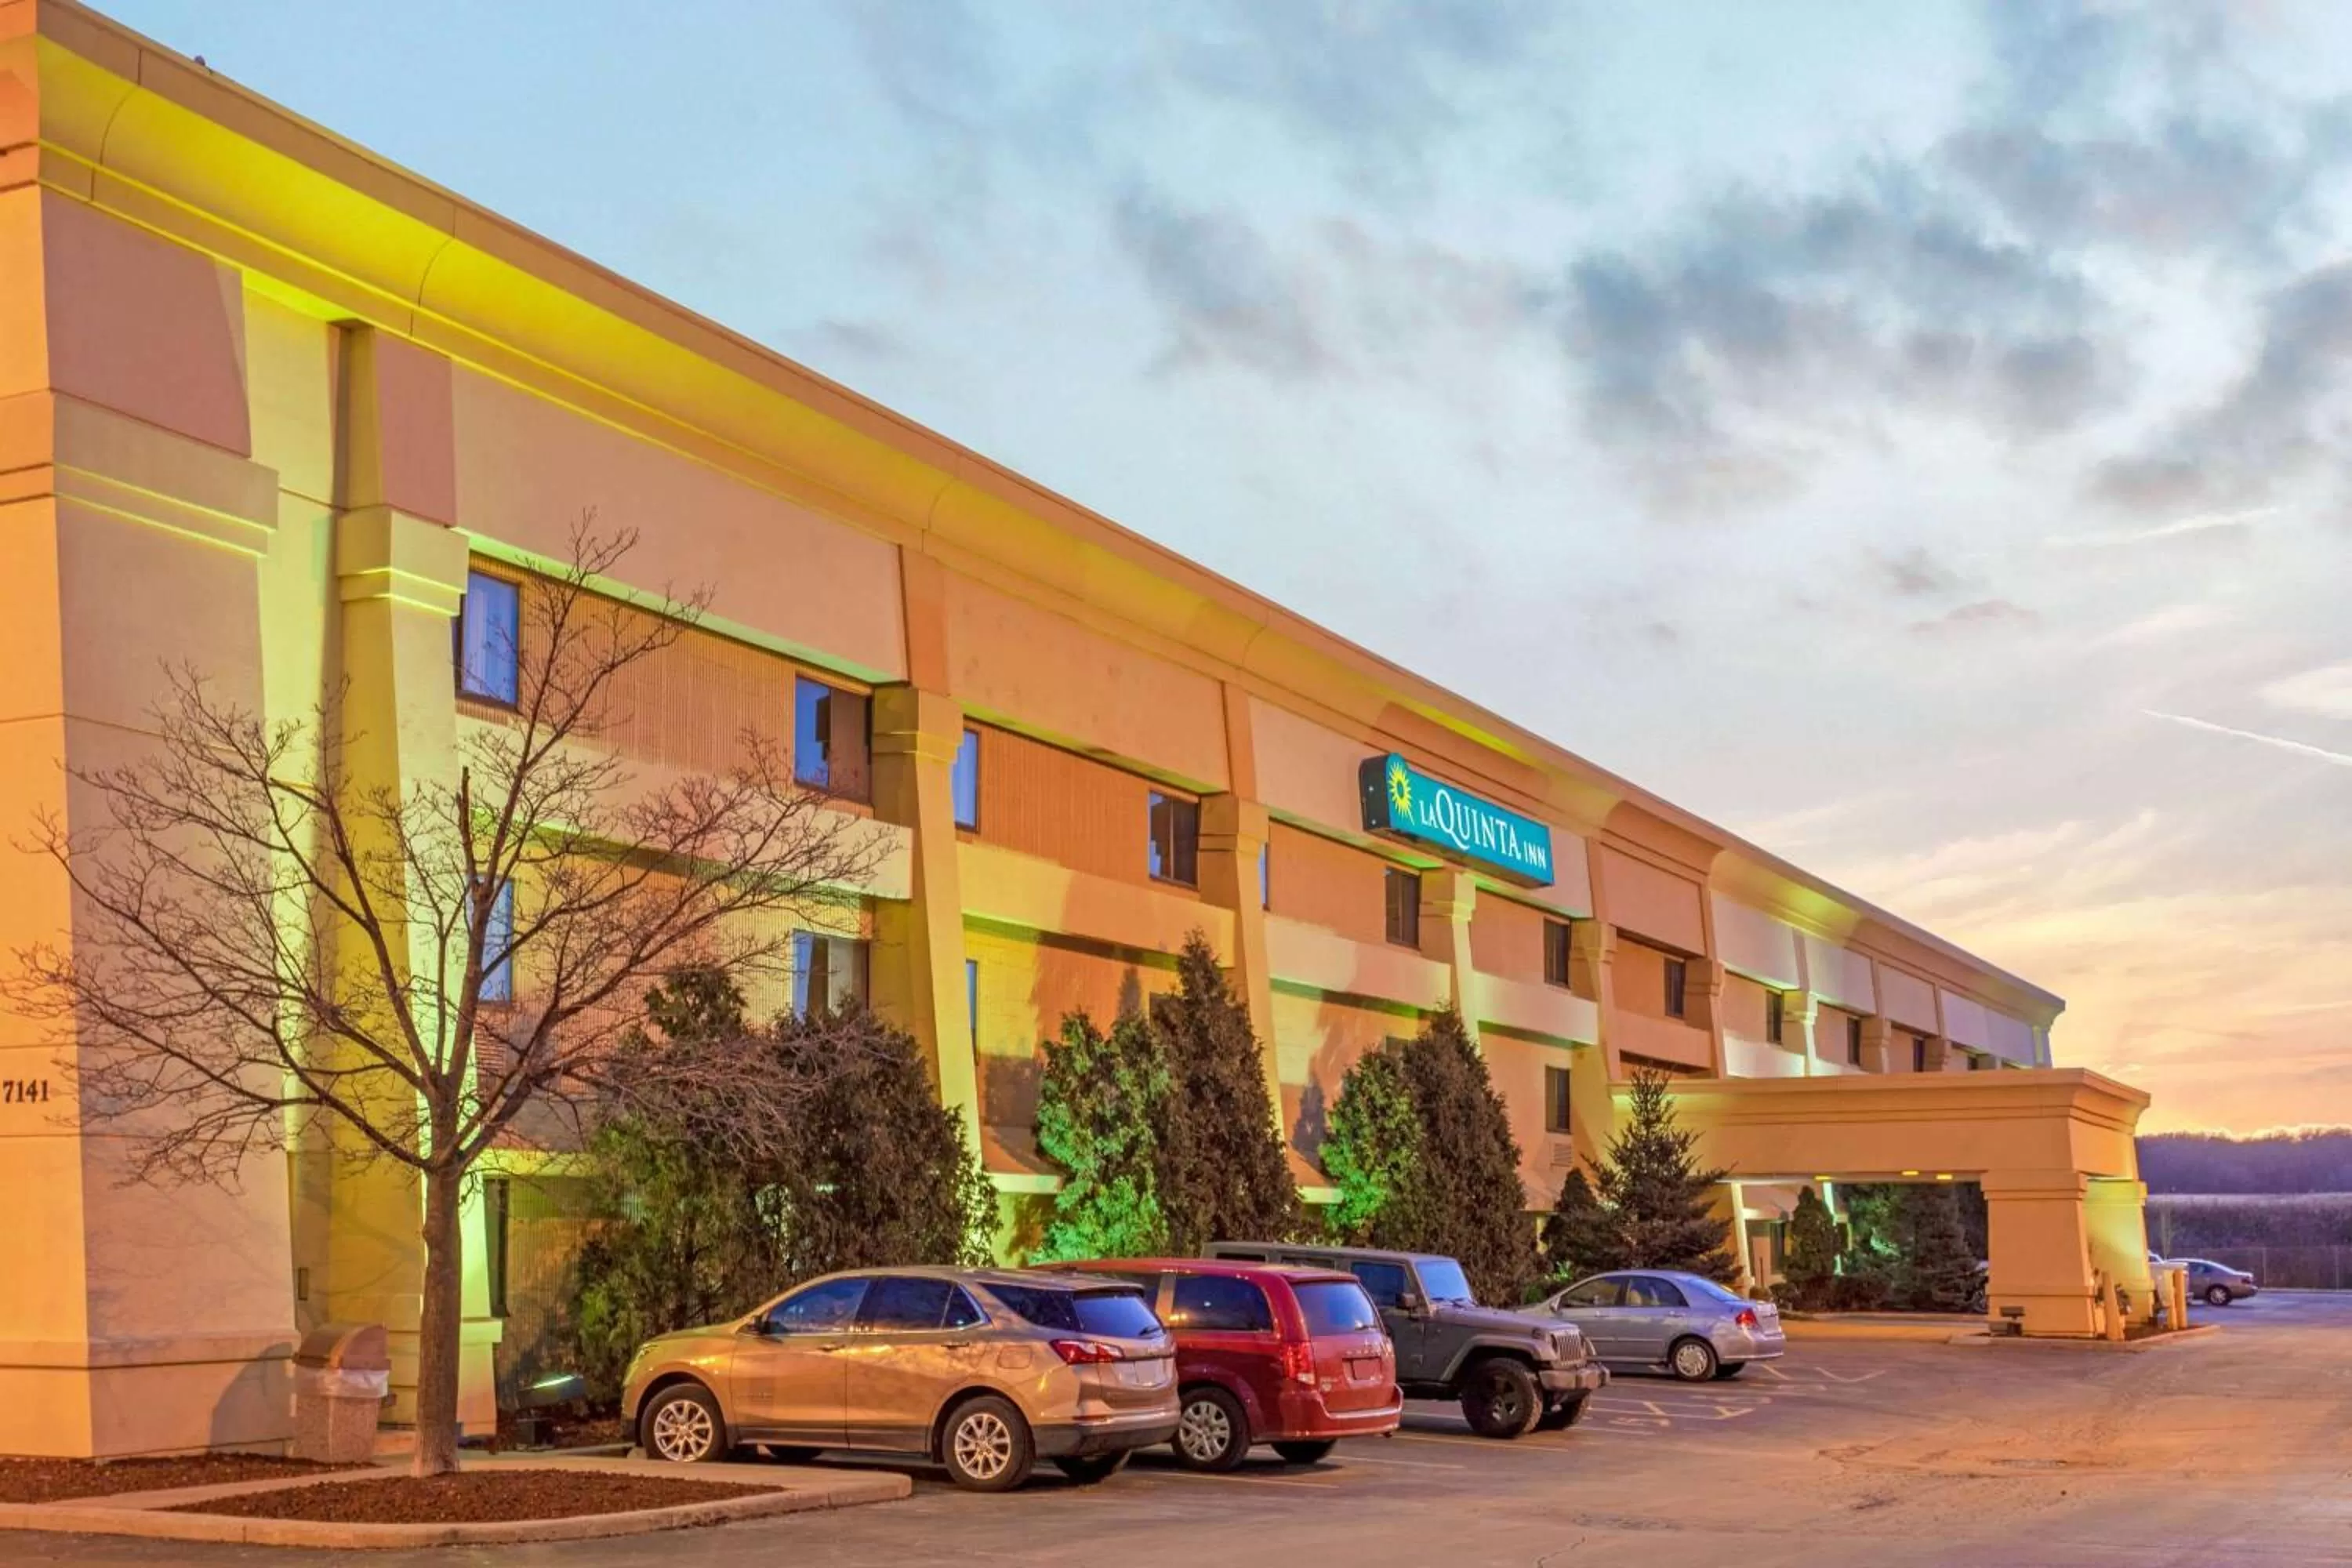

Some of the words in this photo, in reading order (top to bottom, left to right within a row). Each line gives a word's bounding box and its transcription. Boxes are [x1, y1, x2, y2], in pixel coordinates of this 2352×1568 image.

[1419, 800, 1438, 829] LA
[1436, 789, 1521, 861] QUINTA
[1524, 840, 1547, 870] INN
[2, 1079, 49, 1104] 7141
